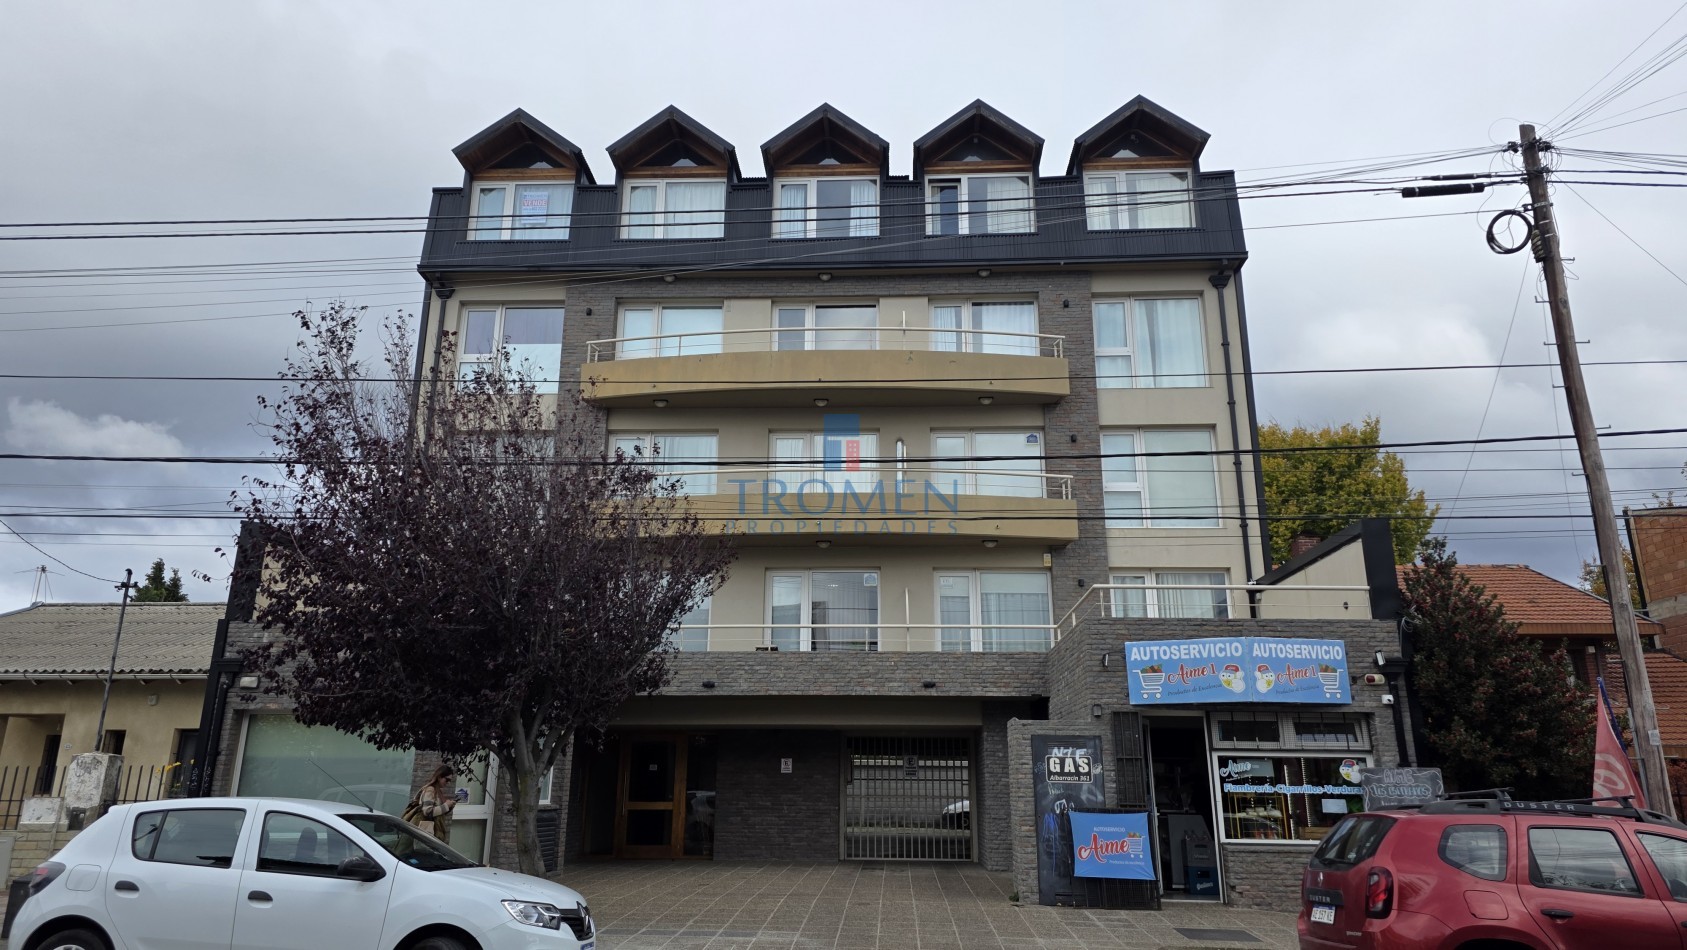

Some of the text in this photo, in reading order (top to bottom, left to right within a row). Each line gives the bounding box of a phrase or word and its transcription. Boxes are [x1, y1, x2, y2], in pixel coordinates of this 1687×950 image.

[1130, 642, 1242, 661] AUTOSERVICIO
[1252, 642, 1343, 660] AUTOSERVICIO
[1166, 663, 1208, 685] Aime
[1276, 663, 1310, 686] Aime
[1049, 757, 1090, 773] GAS
[1503, 801, 1576, 811] DUSTER
[1078, 833, 1130, 863] Aime
[1309, 894, 1331, 903] DUSTER
